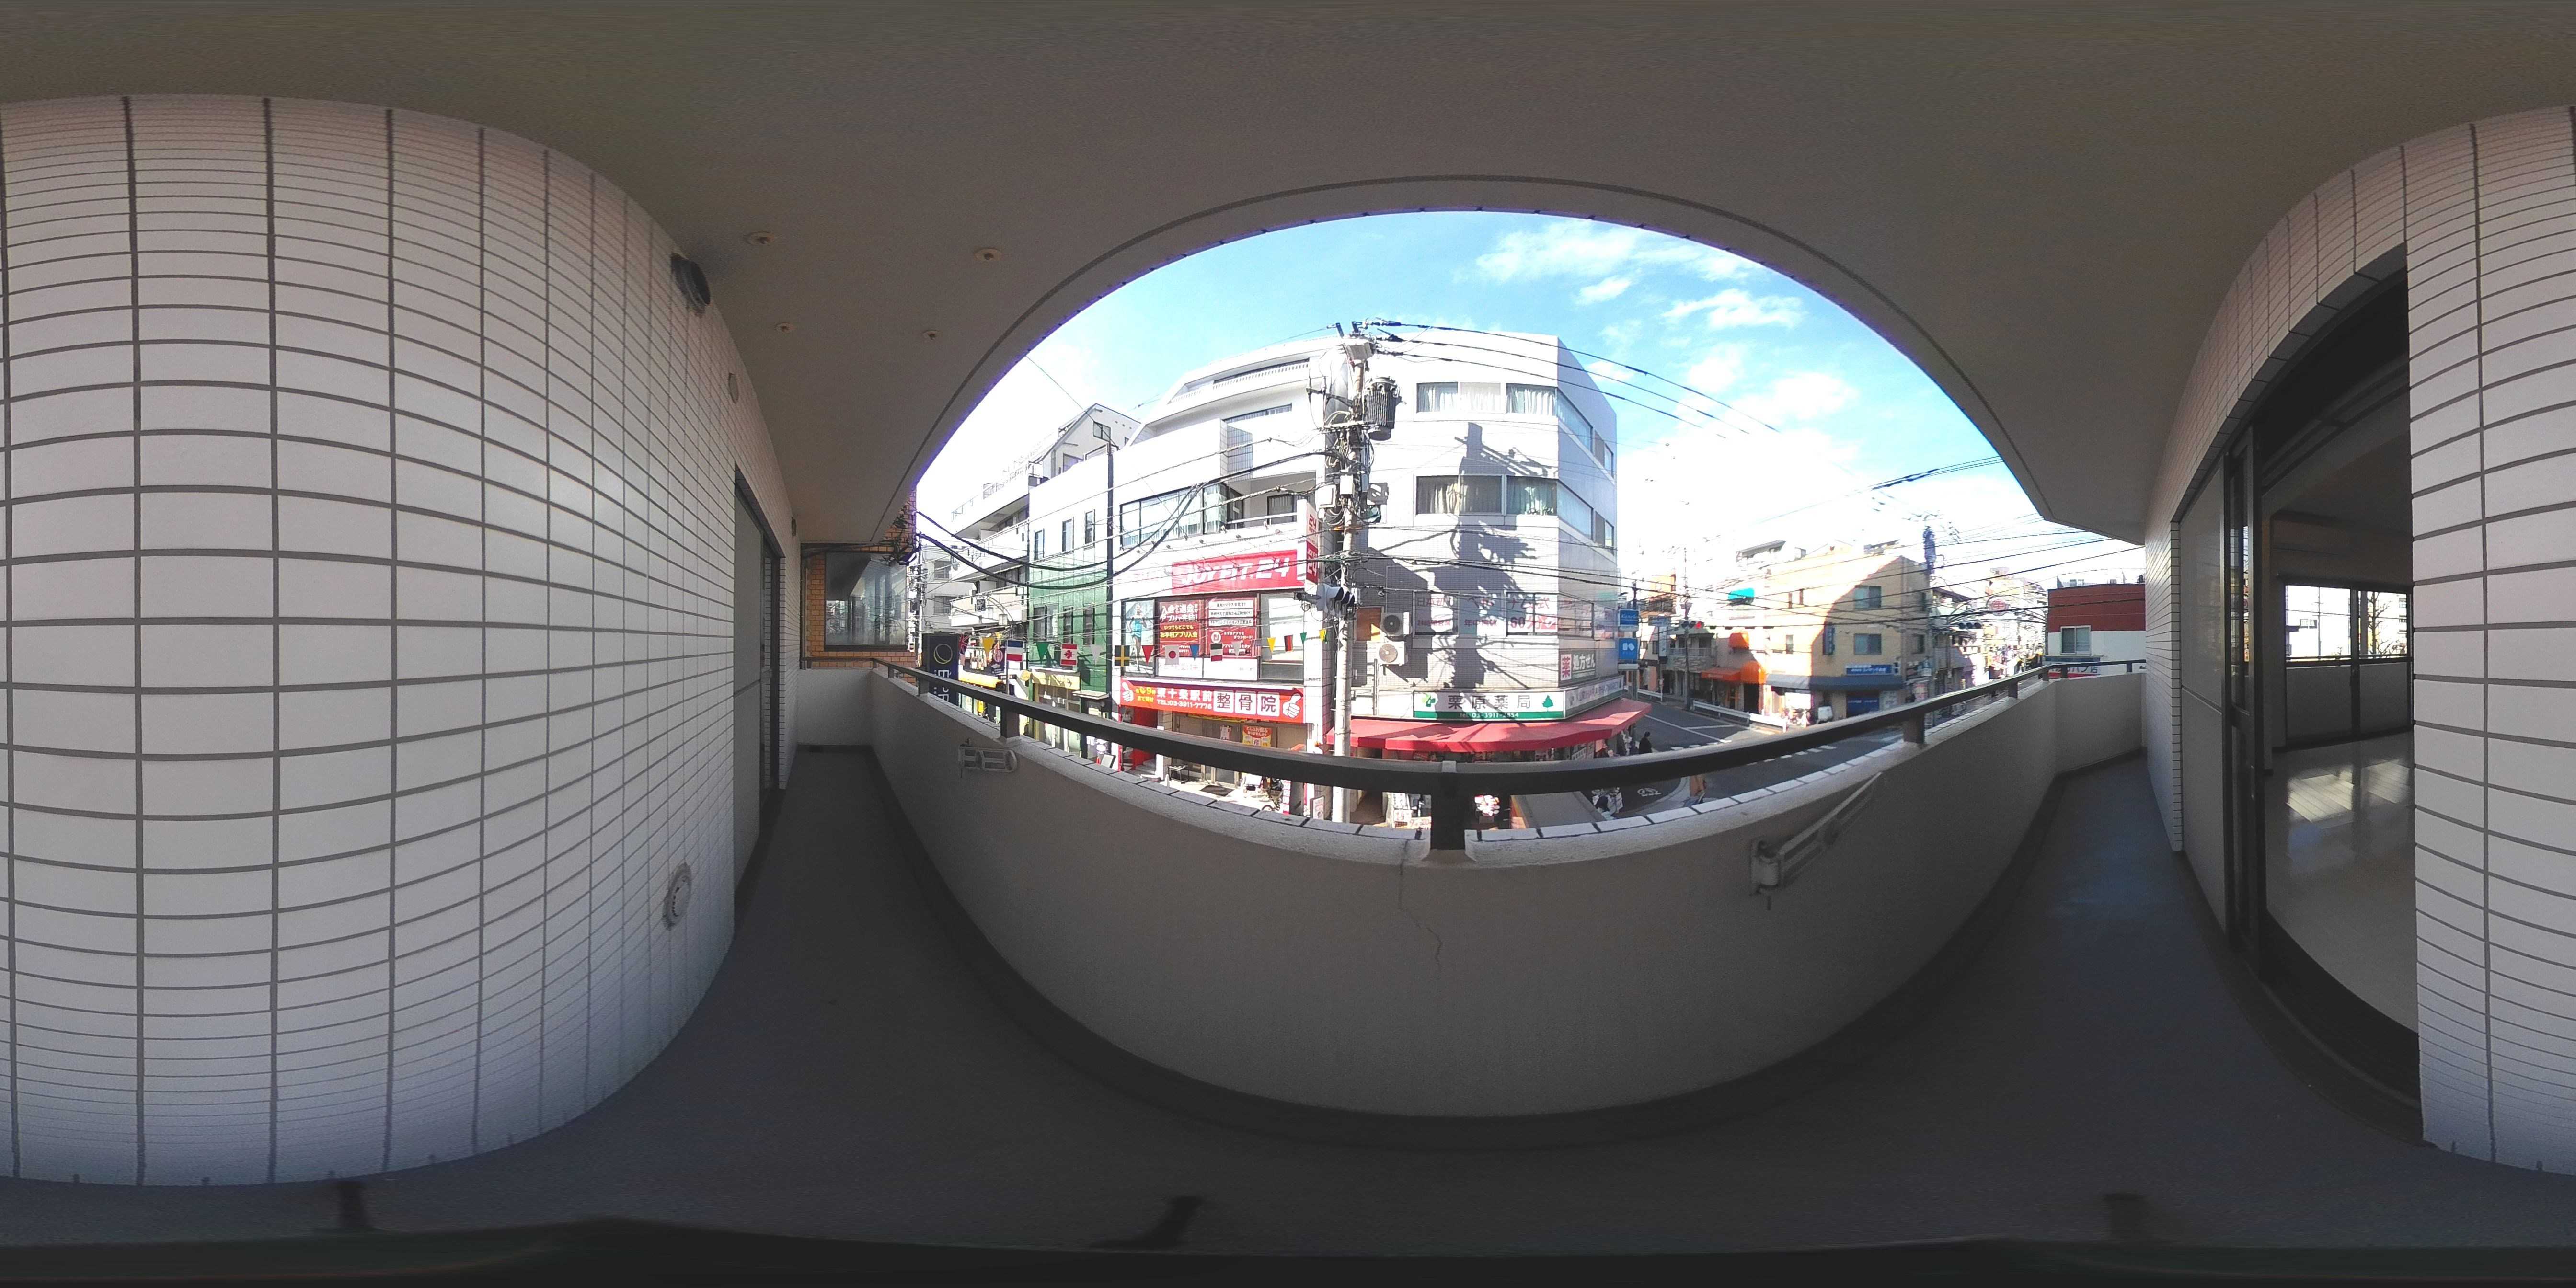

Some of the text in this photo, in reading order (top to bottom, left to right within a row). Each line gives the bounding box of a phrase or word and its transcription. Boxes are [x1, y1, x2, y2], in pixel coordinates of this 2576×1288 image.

[1573, 654, 1596, 670] 処方せん
[1157, 687, 1276, 712] 東十条駅前 整骨院
[1448, 695, 1530, 710] 栗原薬局
